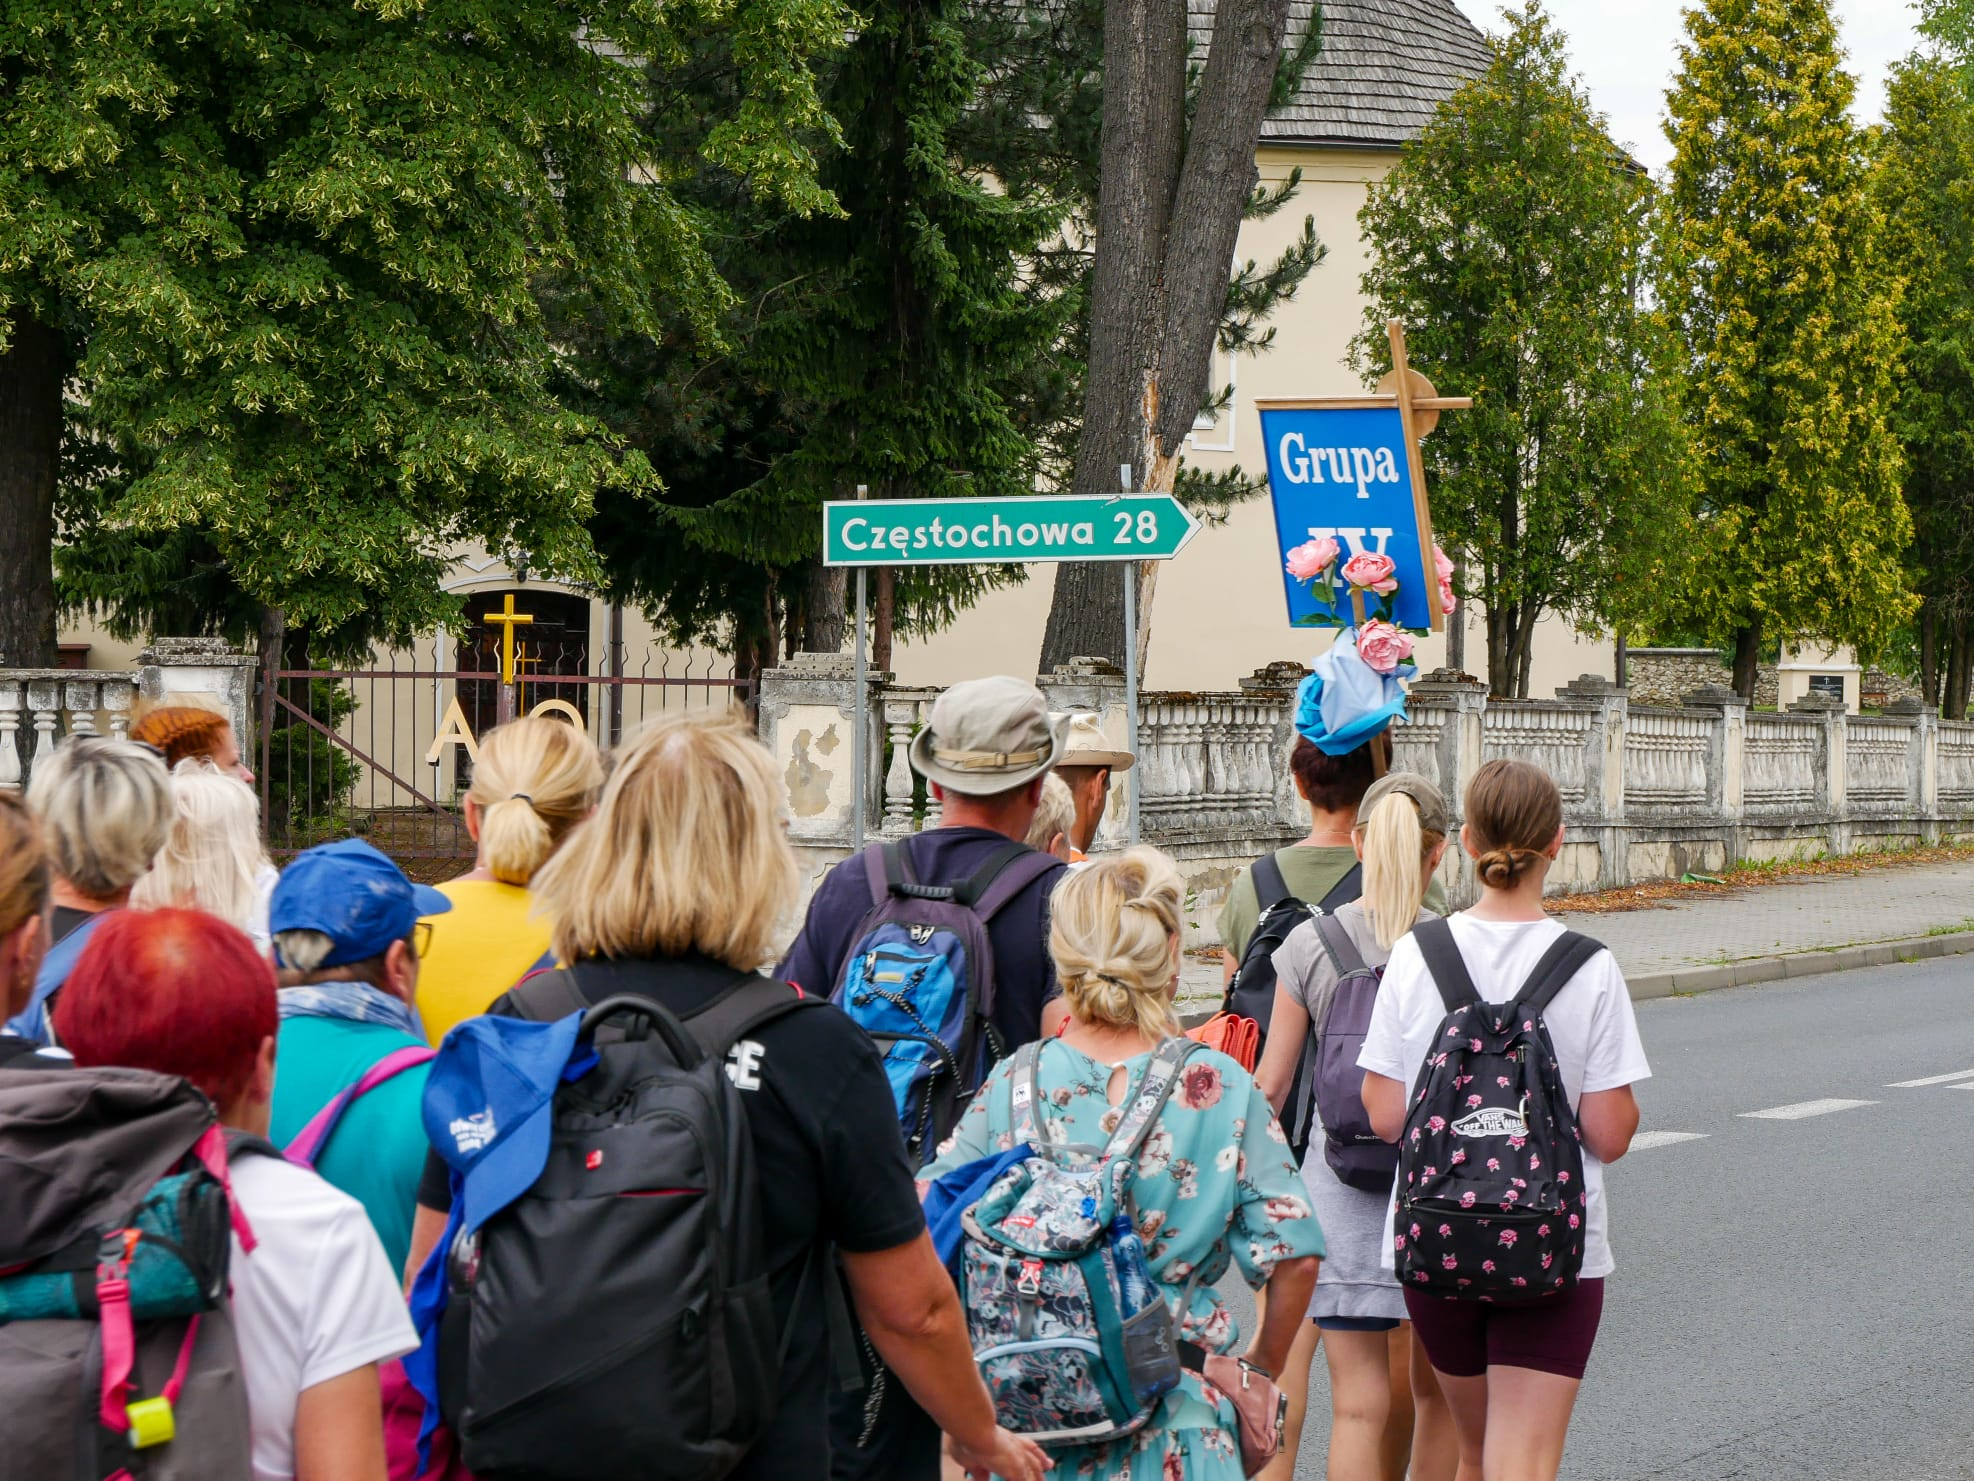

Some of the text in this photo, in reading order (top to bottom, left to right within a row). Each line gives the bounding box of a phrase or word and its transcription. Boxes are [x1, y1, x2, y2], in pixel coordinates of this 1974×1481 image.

[1279, 432, 1399, 499] Grupa
[841, 510, 1158, 558] Częstochowa 28
[1476, 1113, 1505, 1122] VANS
[1482, 1120, 1503, 1130] THE
[1502, 1119, 1524, 1130] WAL
